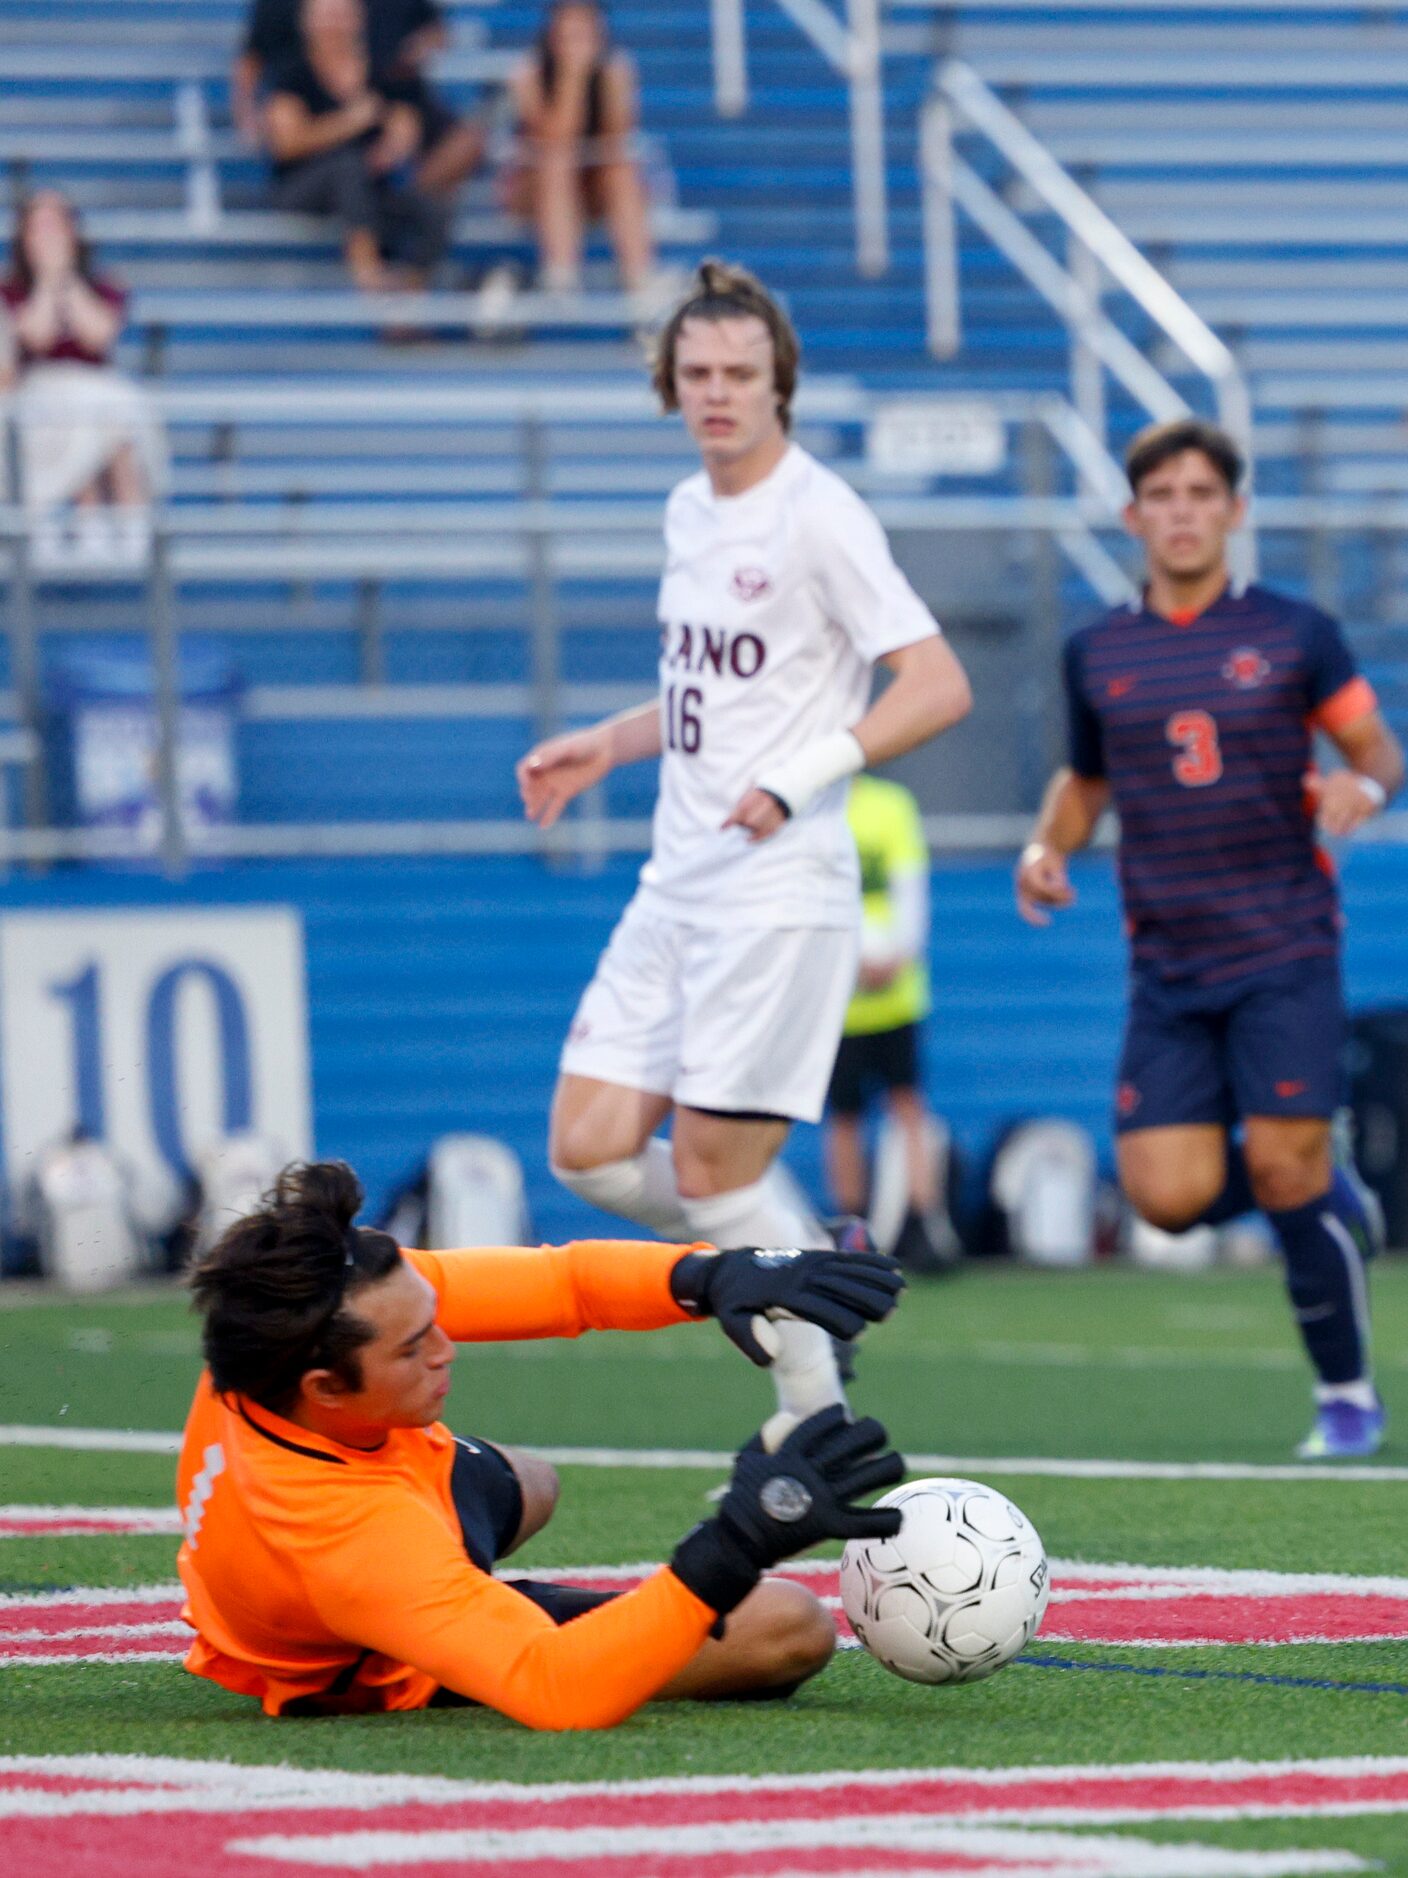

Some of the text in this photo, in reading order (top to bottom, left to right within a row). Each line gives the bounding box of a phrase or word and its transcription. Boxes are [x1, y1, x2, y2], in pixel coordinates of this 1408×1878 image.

[669, 683, 702, 754] 16
[1166, 709, 1223, 788] 3
[46, 955, 252, 1184] 10
